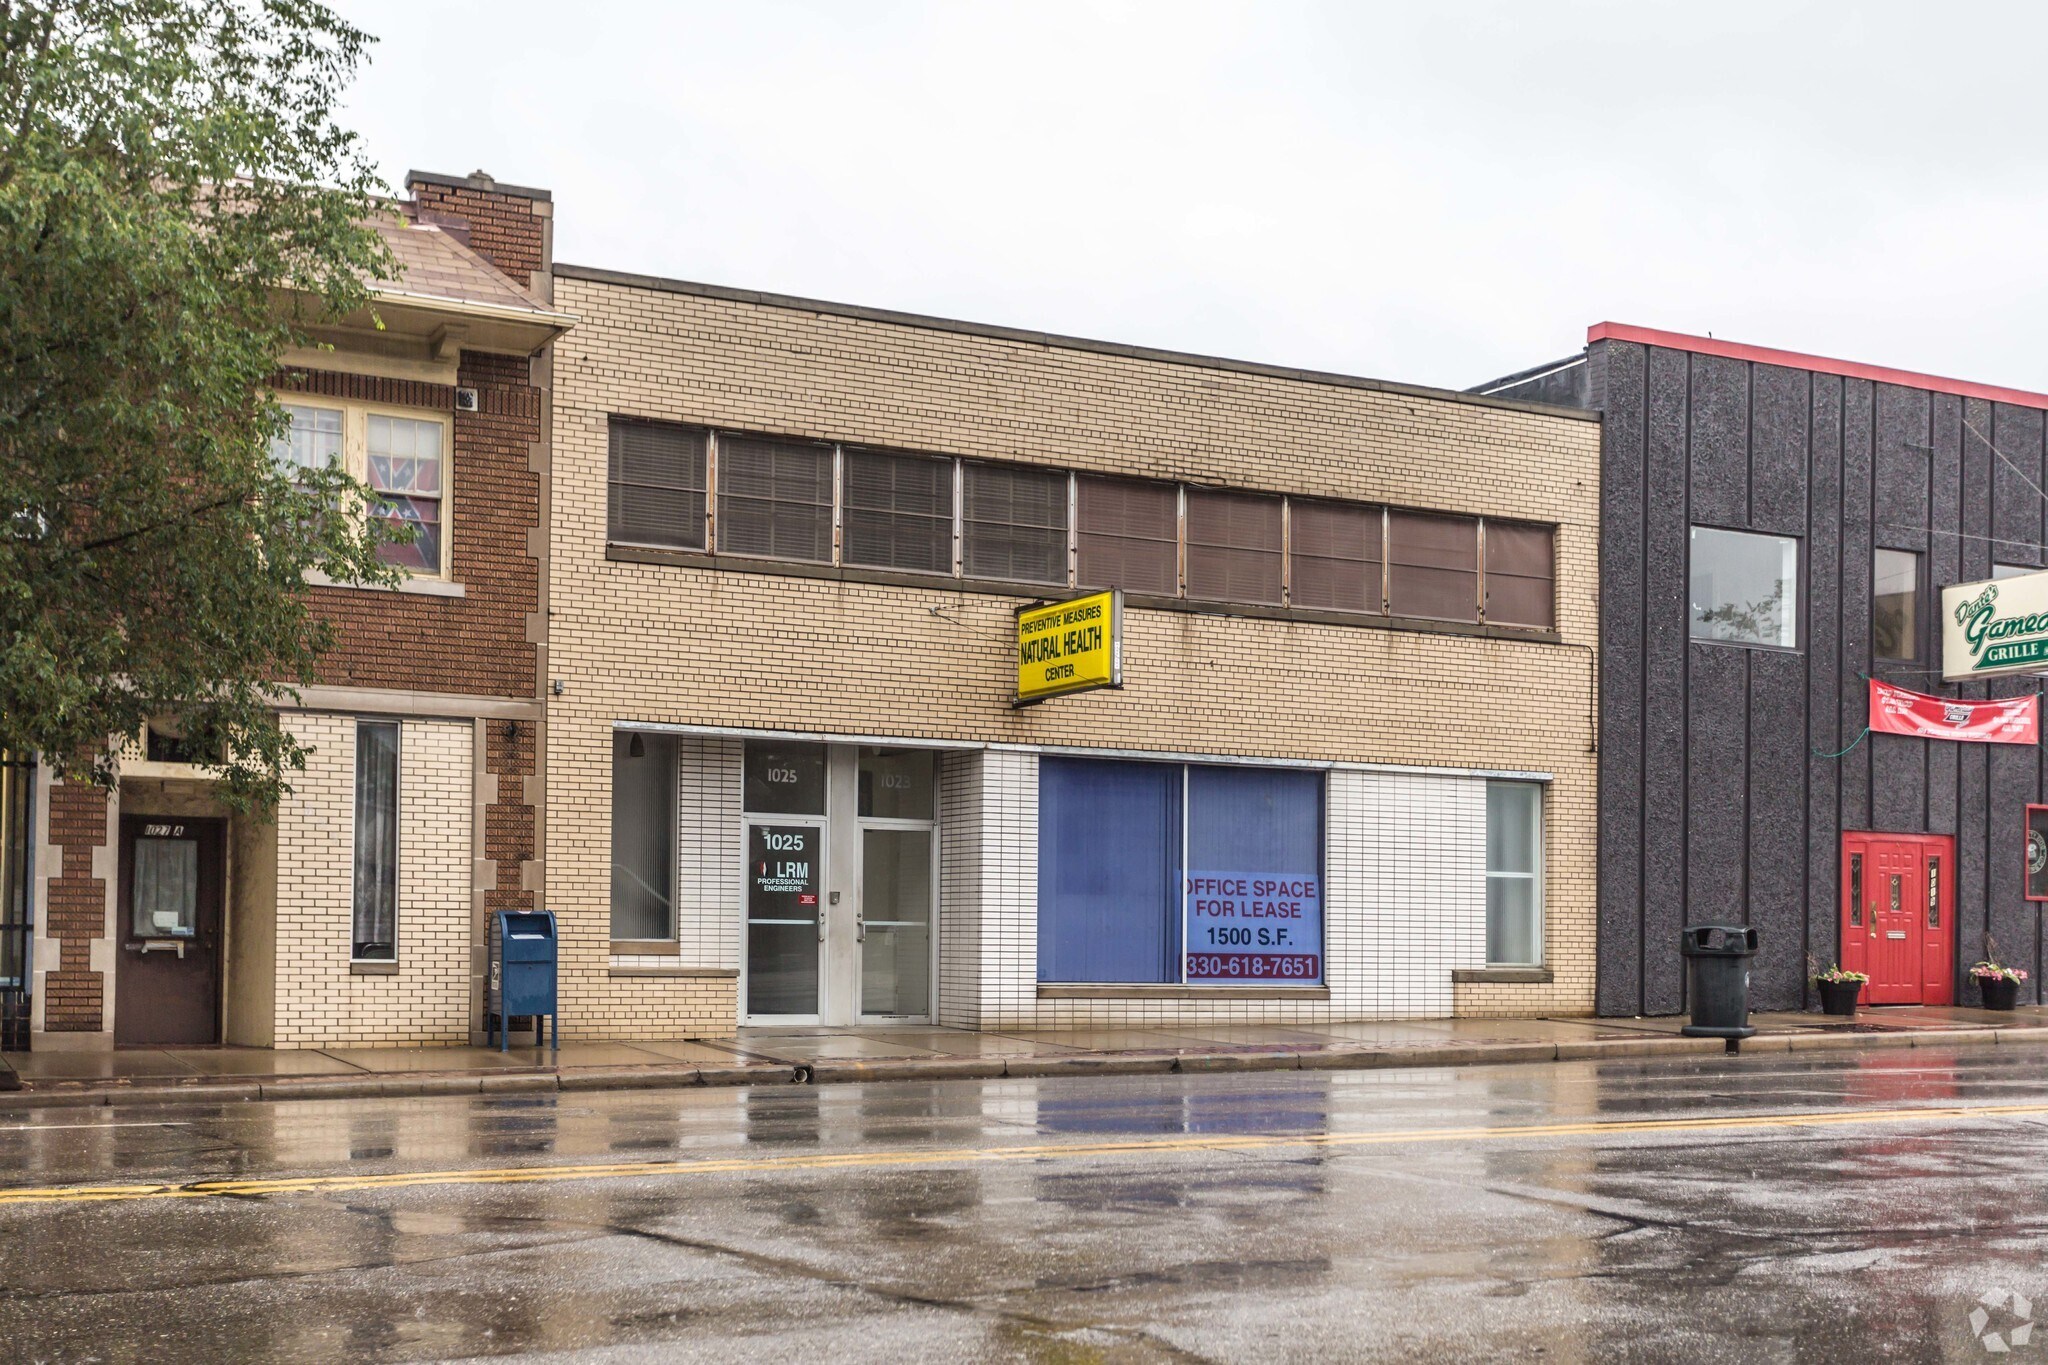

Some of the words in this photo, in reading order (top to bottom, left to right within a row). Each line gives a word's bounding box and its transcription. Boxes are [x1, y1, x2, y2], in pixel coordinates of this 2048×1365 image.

[1955, 584, 1998, 626] Dante's
[1021, 615, 1061, 636] PREVENTIVE
[1063, 605, 1101, 625] MEASURES
[1021, 635, 1061, 665] NATURAL
[1063, 626, 1102, 656] HEALTH
[1988, 642, 2039, 661] GRILLE
[1045, 664, 1074, 681] CENTER
[768, 768, 798, 783] 1025
[145, 824, 171, 835] 1027
[173, 825, 184, 836] A
[763, 833, 804, 851] 1025
[777, 861, 809, 878] LRM
[757, 878, 809, 886] PROFESSIONAL
[763, 884, 802, 892] ENGINEERS
[1253, 880, 1316, 898] SPACE
[1196, 900, 1235, 917] FOR
[1241, 901, 1302, 919] LEASE
[1207, 927, 1252, 945] 1500
[1257, 928, 1293, 946] S.F.
[1186, 956, 1314, 976] 330-618-7651
